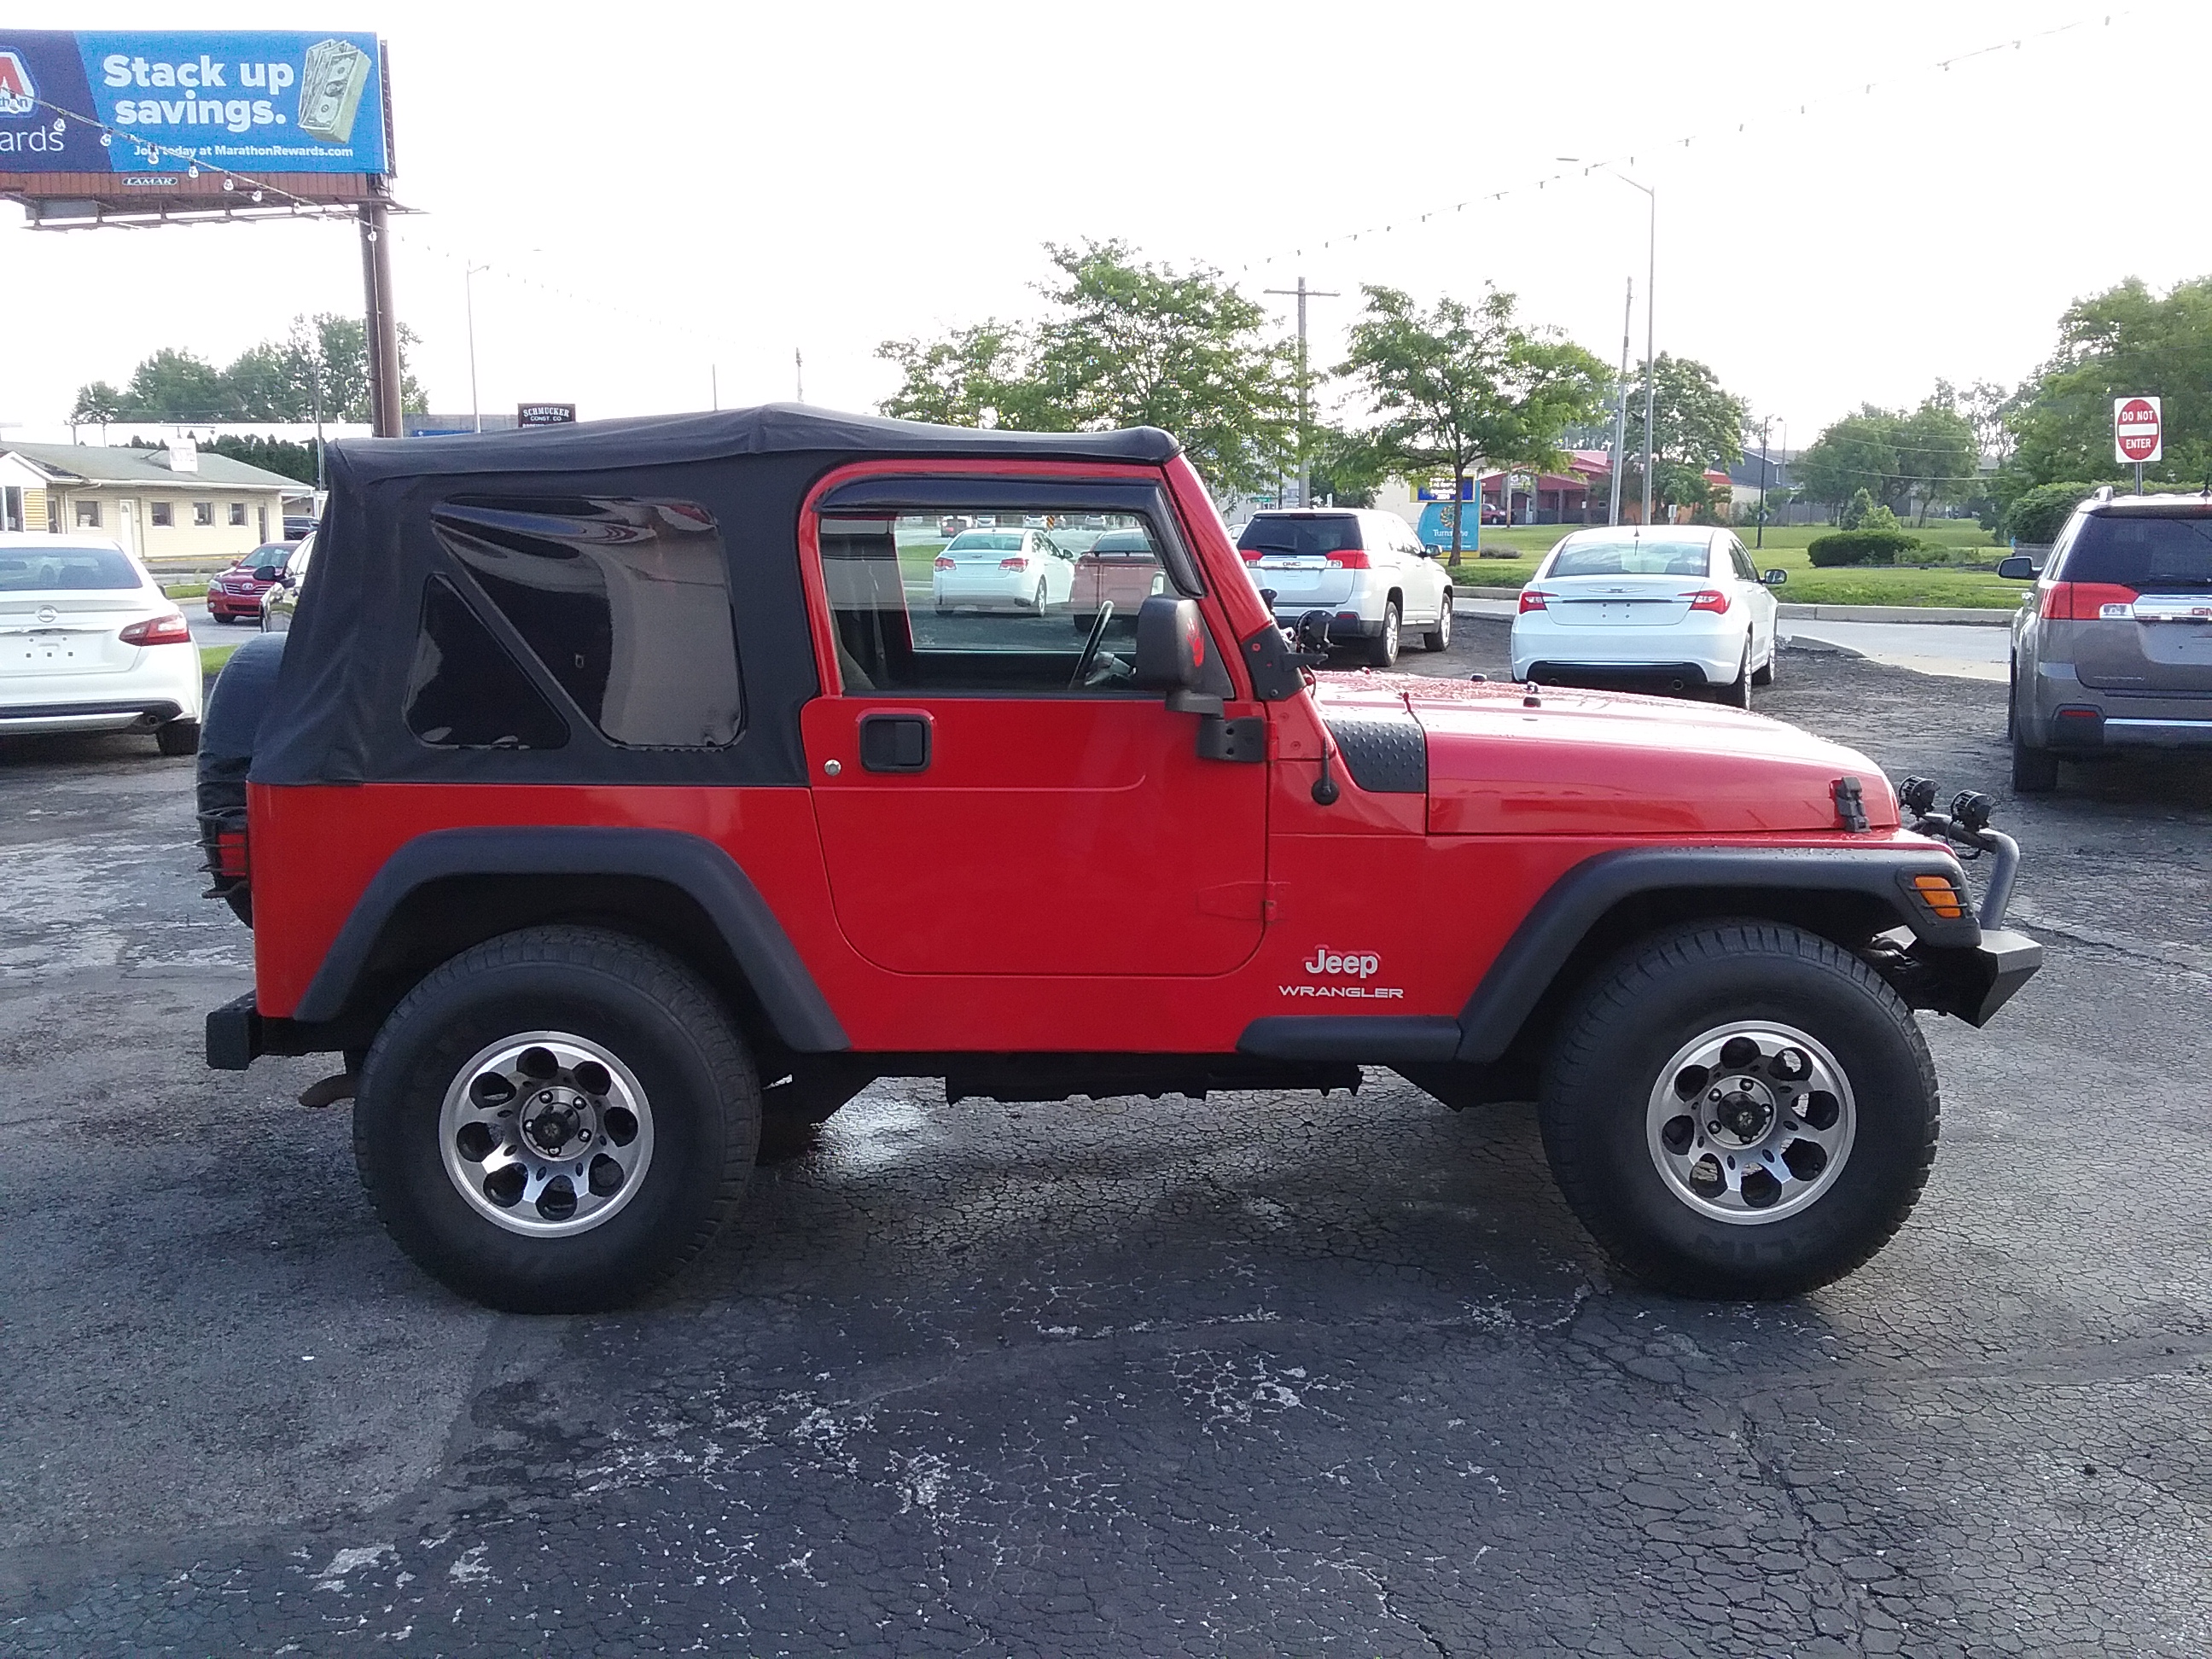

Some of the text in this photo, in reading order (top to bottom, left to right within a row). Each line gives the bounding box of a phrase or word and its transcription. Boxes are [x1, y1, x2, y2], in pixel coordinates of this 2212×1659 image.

[103, 55, 294, 96] Stack up
[114, 89, 287, 132] savings.
[134, 145, 353, 158] Join today at MarathonRewards.com
[522, 406, 570, 417] SCHMUCKER
[2122, 410, 2153, 422] DO NOT
[2126, 438, 2151, 450] ENTER
[1432, 528, 1469, 538] Turnsne
[1305, 949, 1378, 979] Jeep
[1278, 986, 1404, 998] WRANGLER
